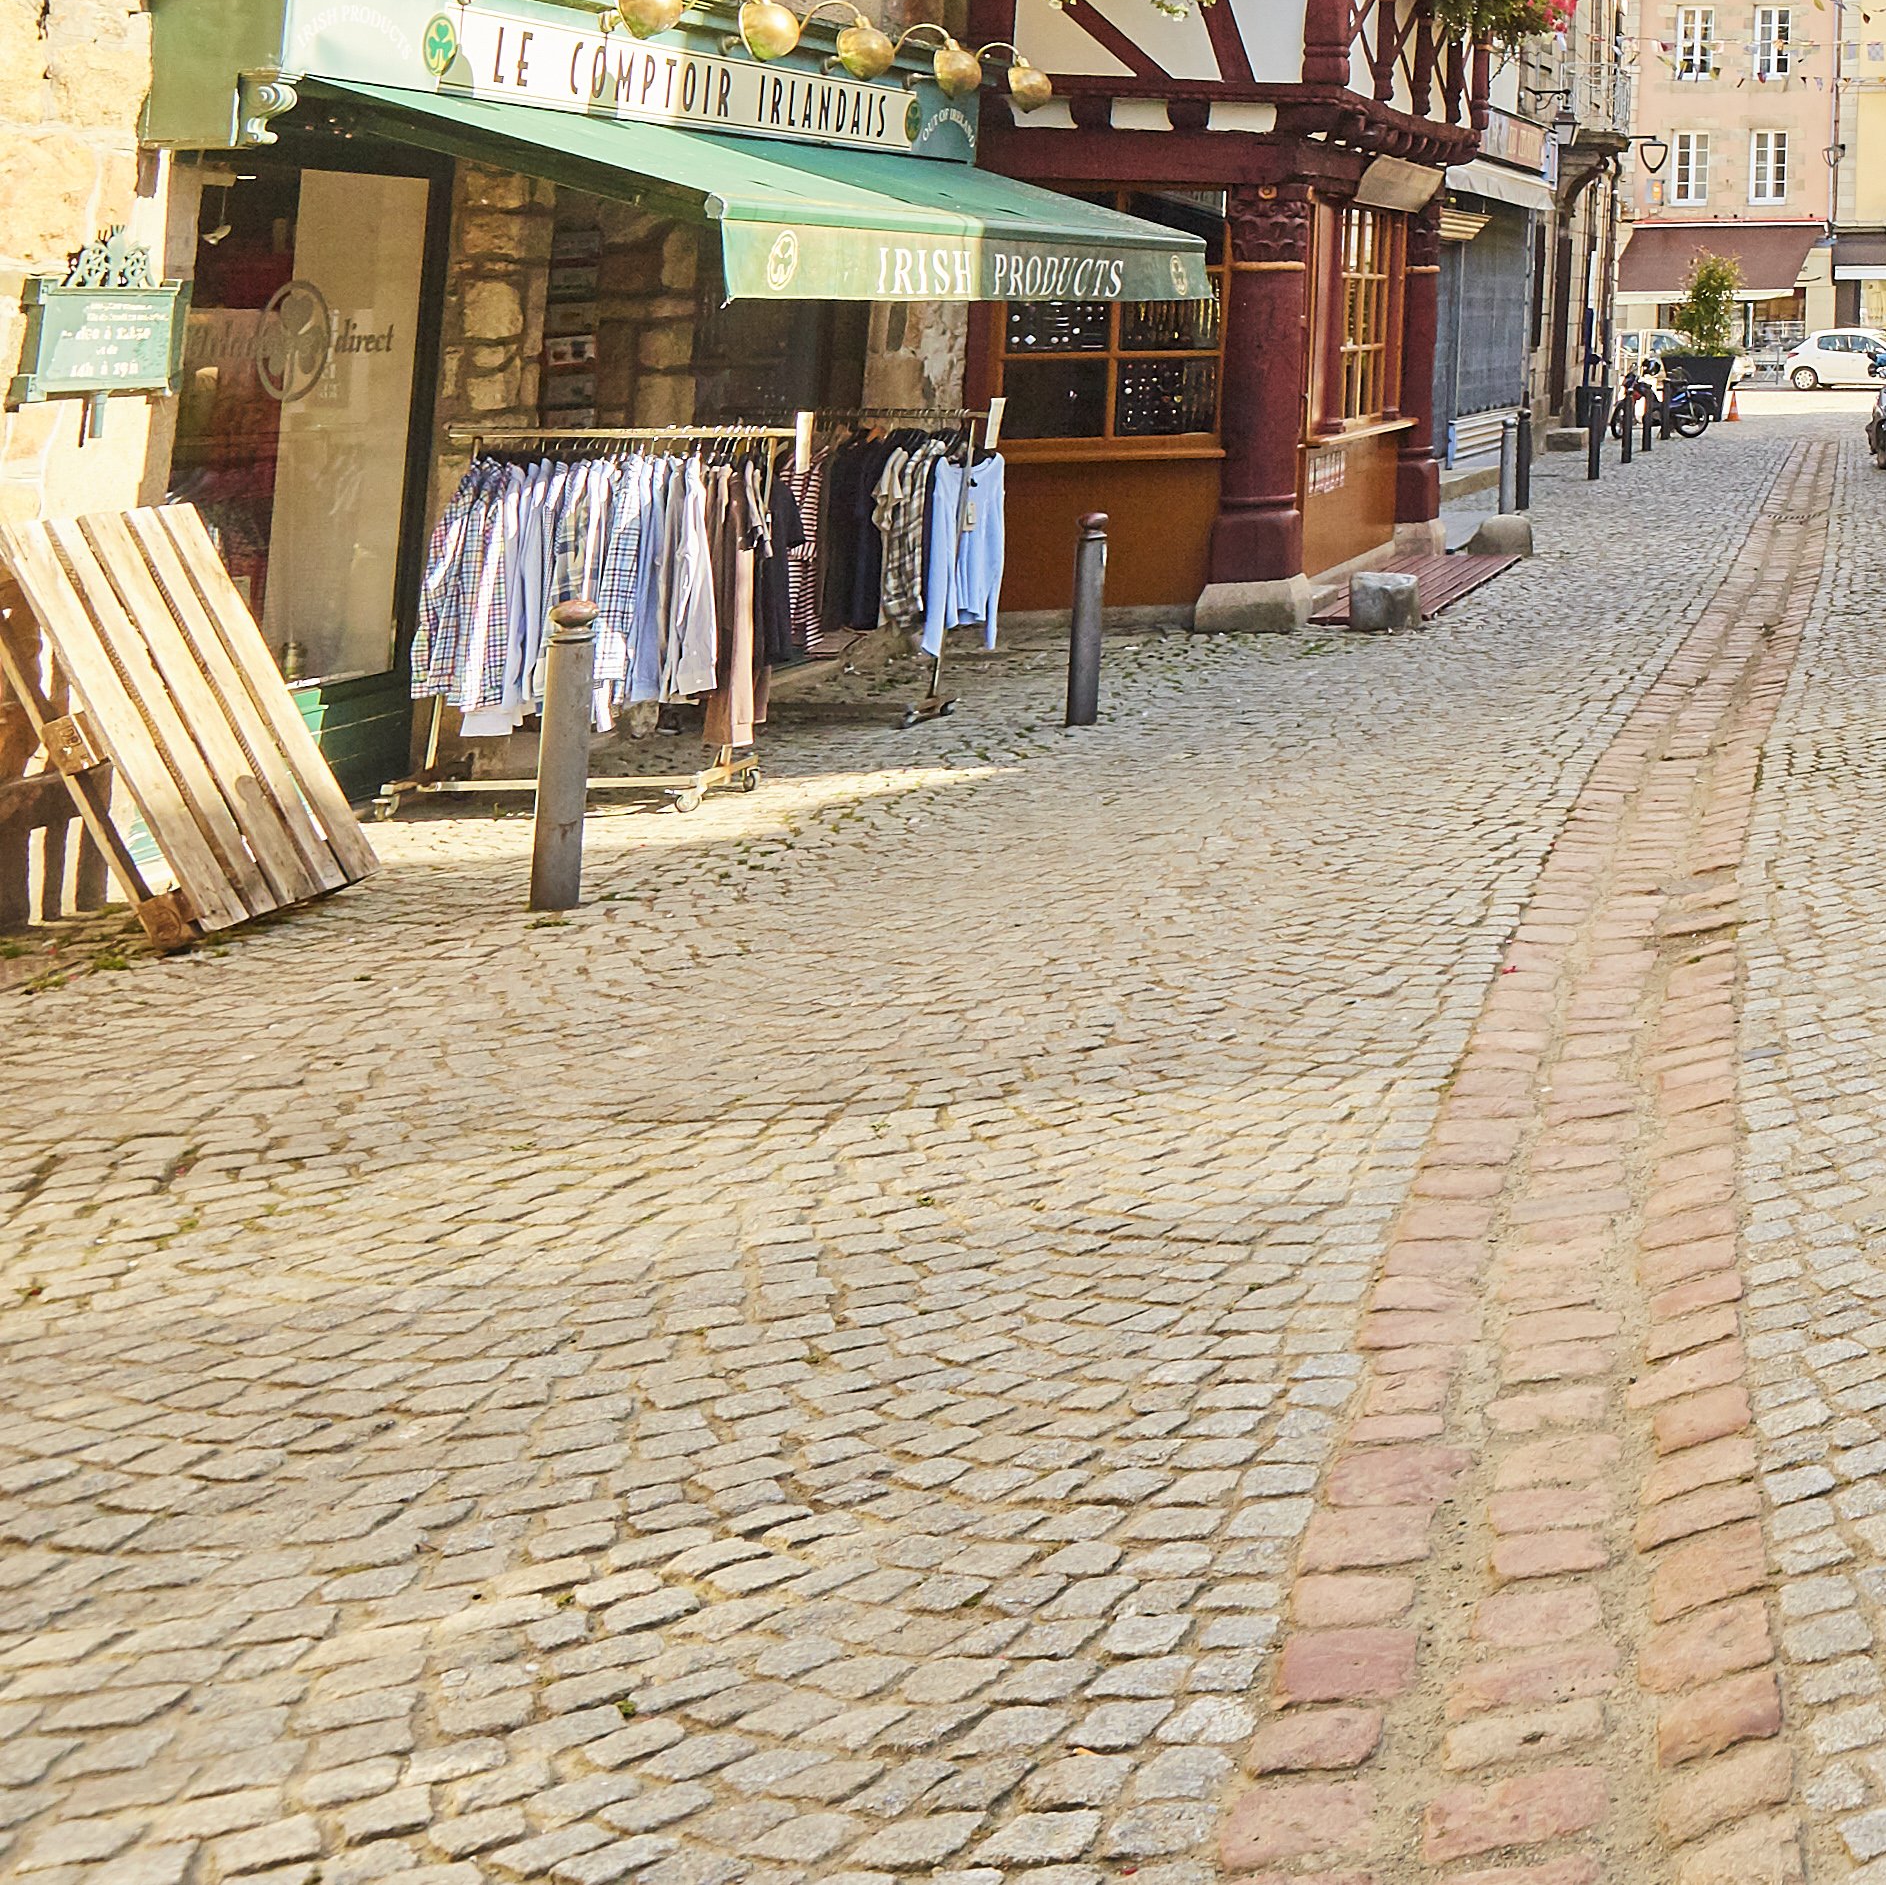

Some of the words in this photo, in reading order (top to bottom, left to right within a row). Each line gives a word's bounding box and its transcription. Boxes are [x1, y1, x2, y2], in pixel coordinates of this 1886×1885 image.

[297, 6, 337, 48] IRISH
[342, 4, 413, 60] PRODUCTS
[493, 26, 533, 87] LE
[570, 42, 732, 117] COMPTOIR
[758, 75, 886, 138] IRLANDAIS
[922, 114, 939, 141] OUT
[876, 247, 971, 295] IRISH
[993, 253, 1124, 298] PRODUCTS
[336, 318, 394, 353] direct
